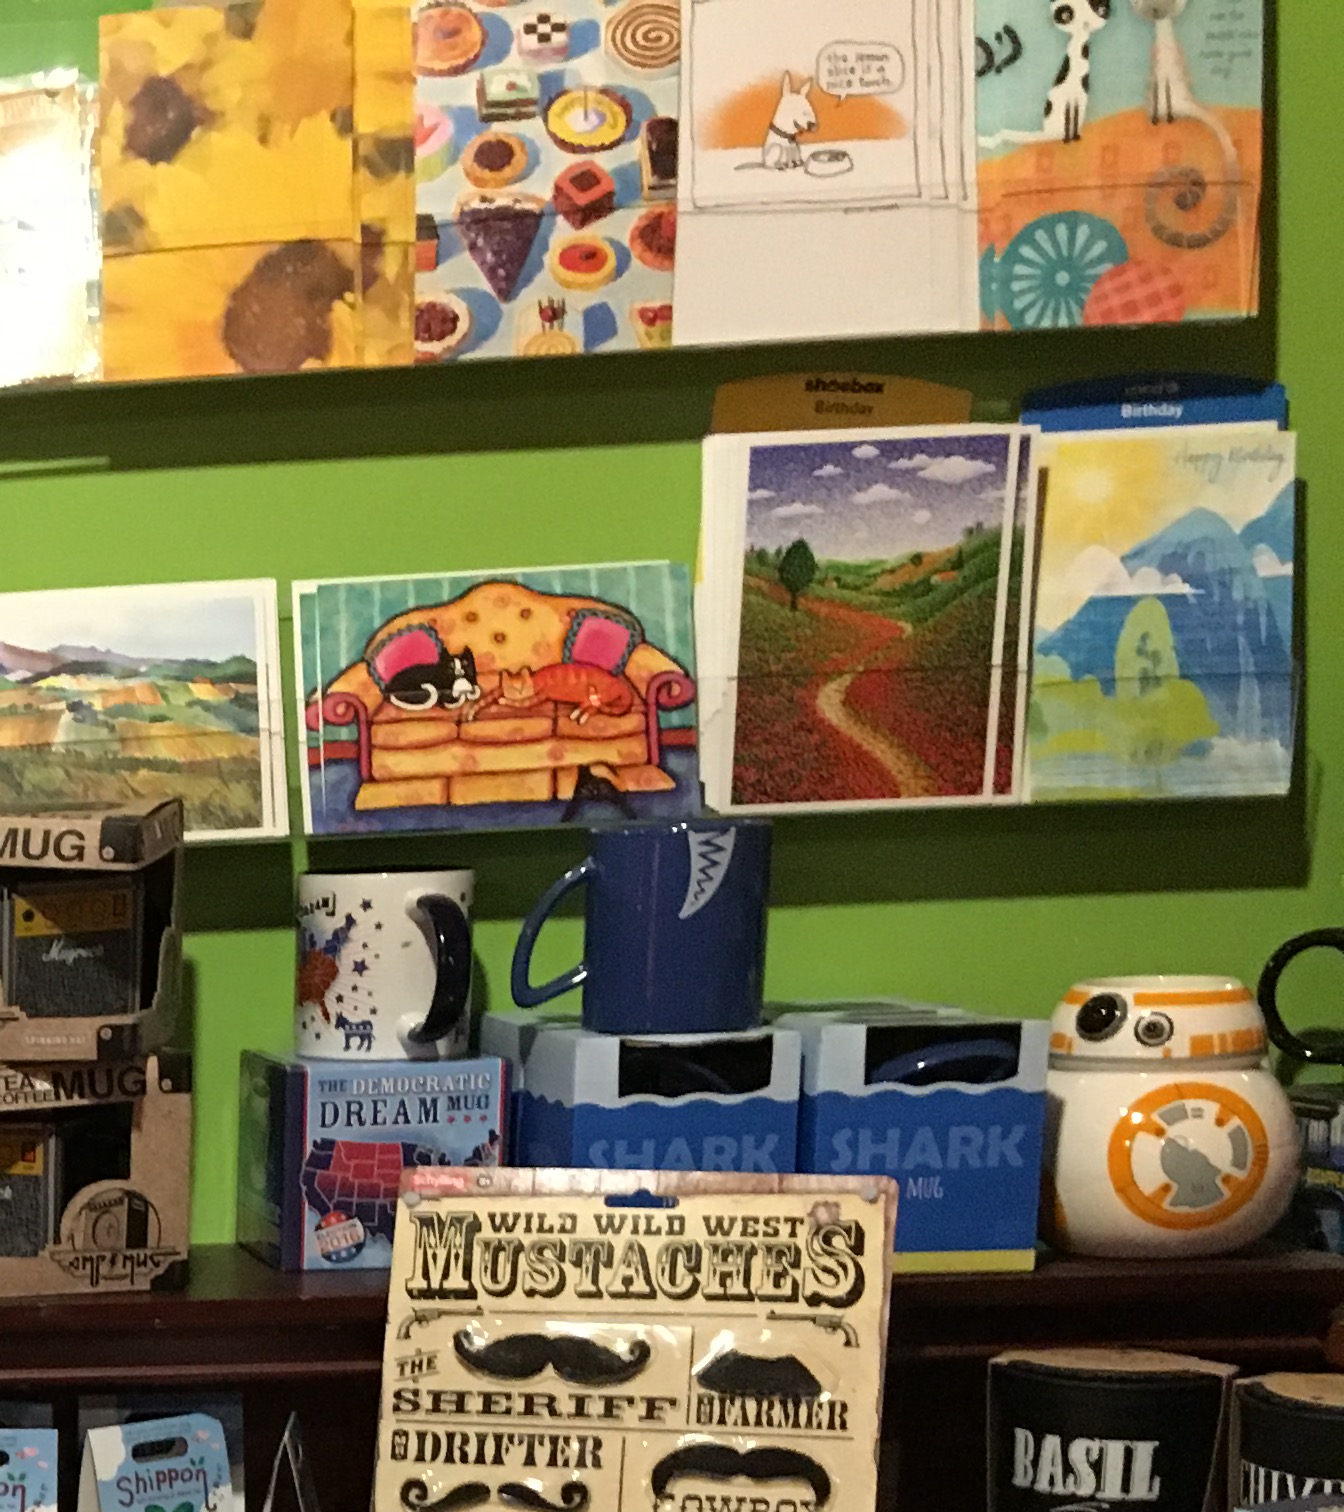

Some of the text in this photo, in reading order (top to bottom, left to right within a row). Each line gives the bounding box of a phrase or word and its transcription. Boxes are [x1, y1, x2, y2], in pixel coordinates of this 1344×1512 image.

[1120, 401, 1184, 422] Birthday
[51, 1065, 147, 1101] MUG
[316, 1072, 492, 1096] THE DEMOCRATIC
[319, 1094, 490, 1130] DREAM MUG
[588, 1132, 780, 1174] SHARK
[830, 1124, 1030, 1171] SHARK
[905, 1176, 945, 1199] MUG
[488, 1212, 805, 1238] WILD WILD WEST
[406, 1210, 866, 1307] MUSTACHES
[395, 1354, 438, 1380] THE
[392, 1389, 679, 1423] SHERIFF
[715, 1397, 850, 1431] FARMER
[414, 1430, 604, 1469] DRIFTER
[1011, 1426, 1161, 1502] BASIL
[115, 1463, 219, 1512] Shippon
